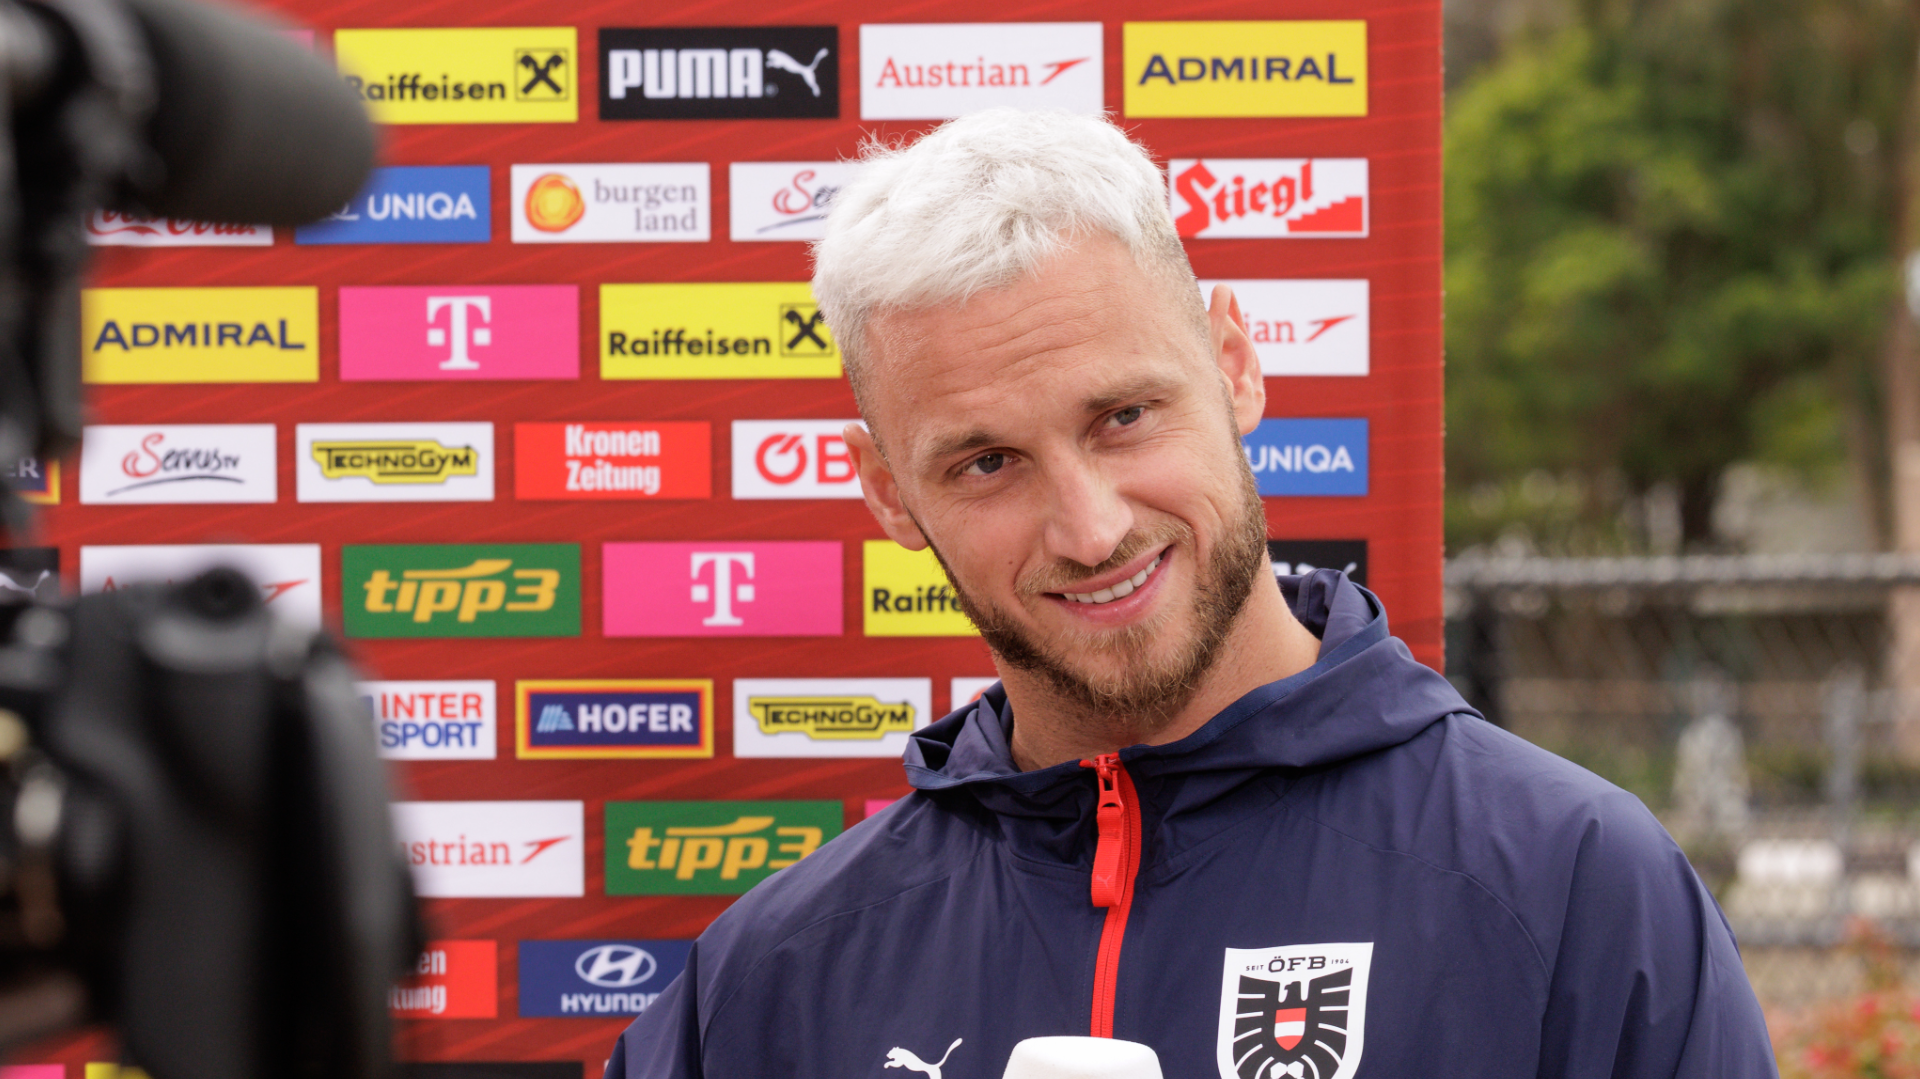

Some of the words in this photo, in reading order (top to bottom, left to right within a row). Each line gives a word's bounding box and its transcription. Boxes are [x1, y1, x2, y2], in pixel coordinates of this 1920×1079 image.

[876, 57, 1031, 88] Austrian
[1138, 53, 1354, 86] ADMIRAL
[367, 191, 477, 221] UNIQA
[594, 180, 698, 208] burgen
[1174, 158, 1315, 237] Stiegl
[634, 208, 698, 233] land
[92, 319, 306, 351] ADMIRAL
[427, 296, 491, 370] T
[608, 329, 771, 357] Raiffeisen
[565, 425, 660, 457] Kronen
[755, 432, 861, 485] ÖB
[1246, 445, 1354, 473] UNIQA
[565, 460, 660, 495] Zeitung
[363, 559, 561, 622] tipp3
[690, 552, 755, 627] T
[381, 694, 482, 718] INTER
[578, 703, 693, 734] HOFER
[380, 722, 482, 749] SPORT
[405, 834, 511, 866] strian
[626, 816, 823, 880] tipp3
[1268, 955, 1326, 973] ÖFB
[561, 993, 657, 1013] HYUND
